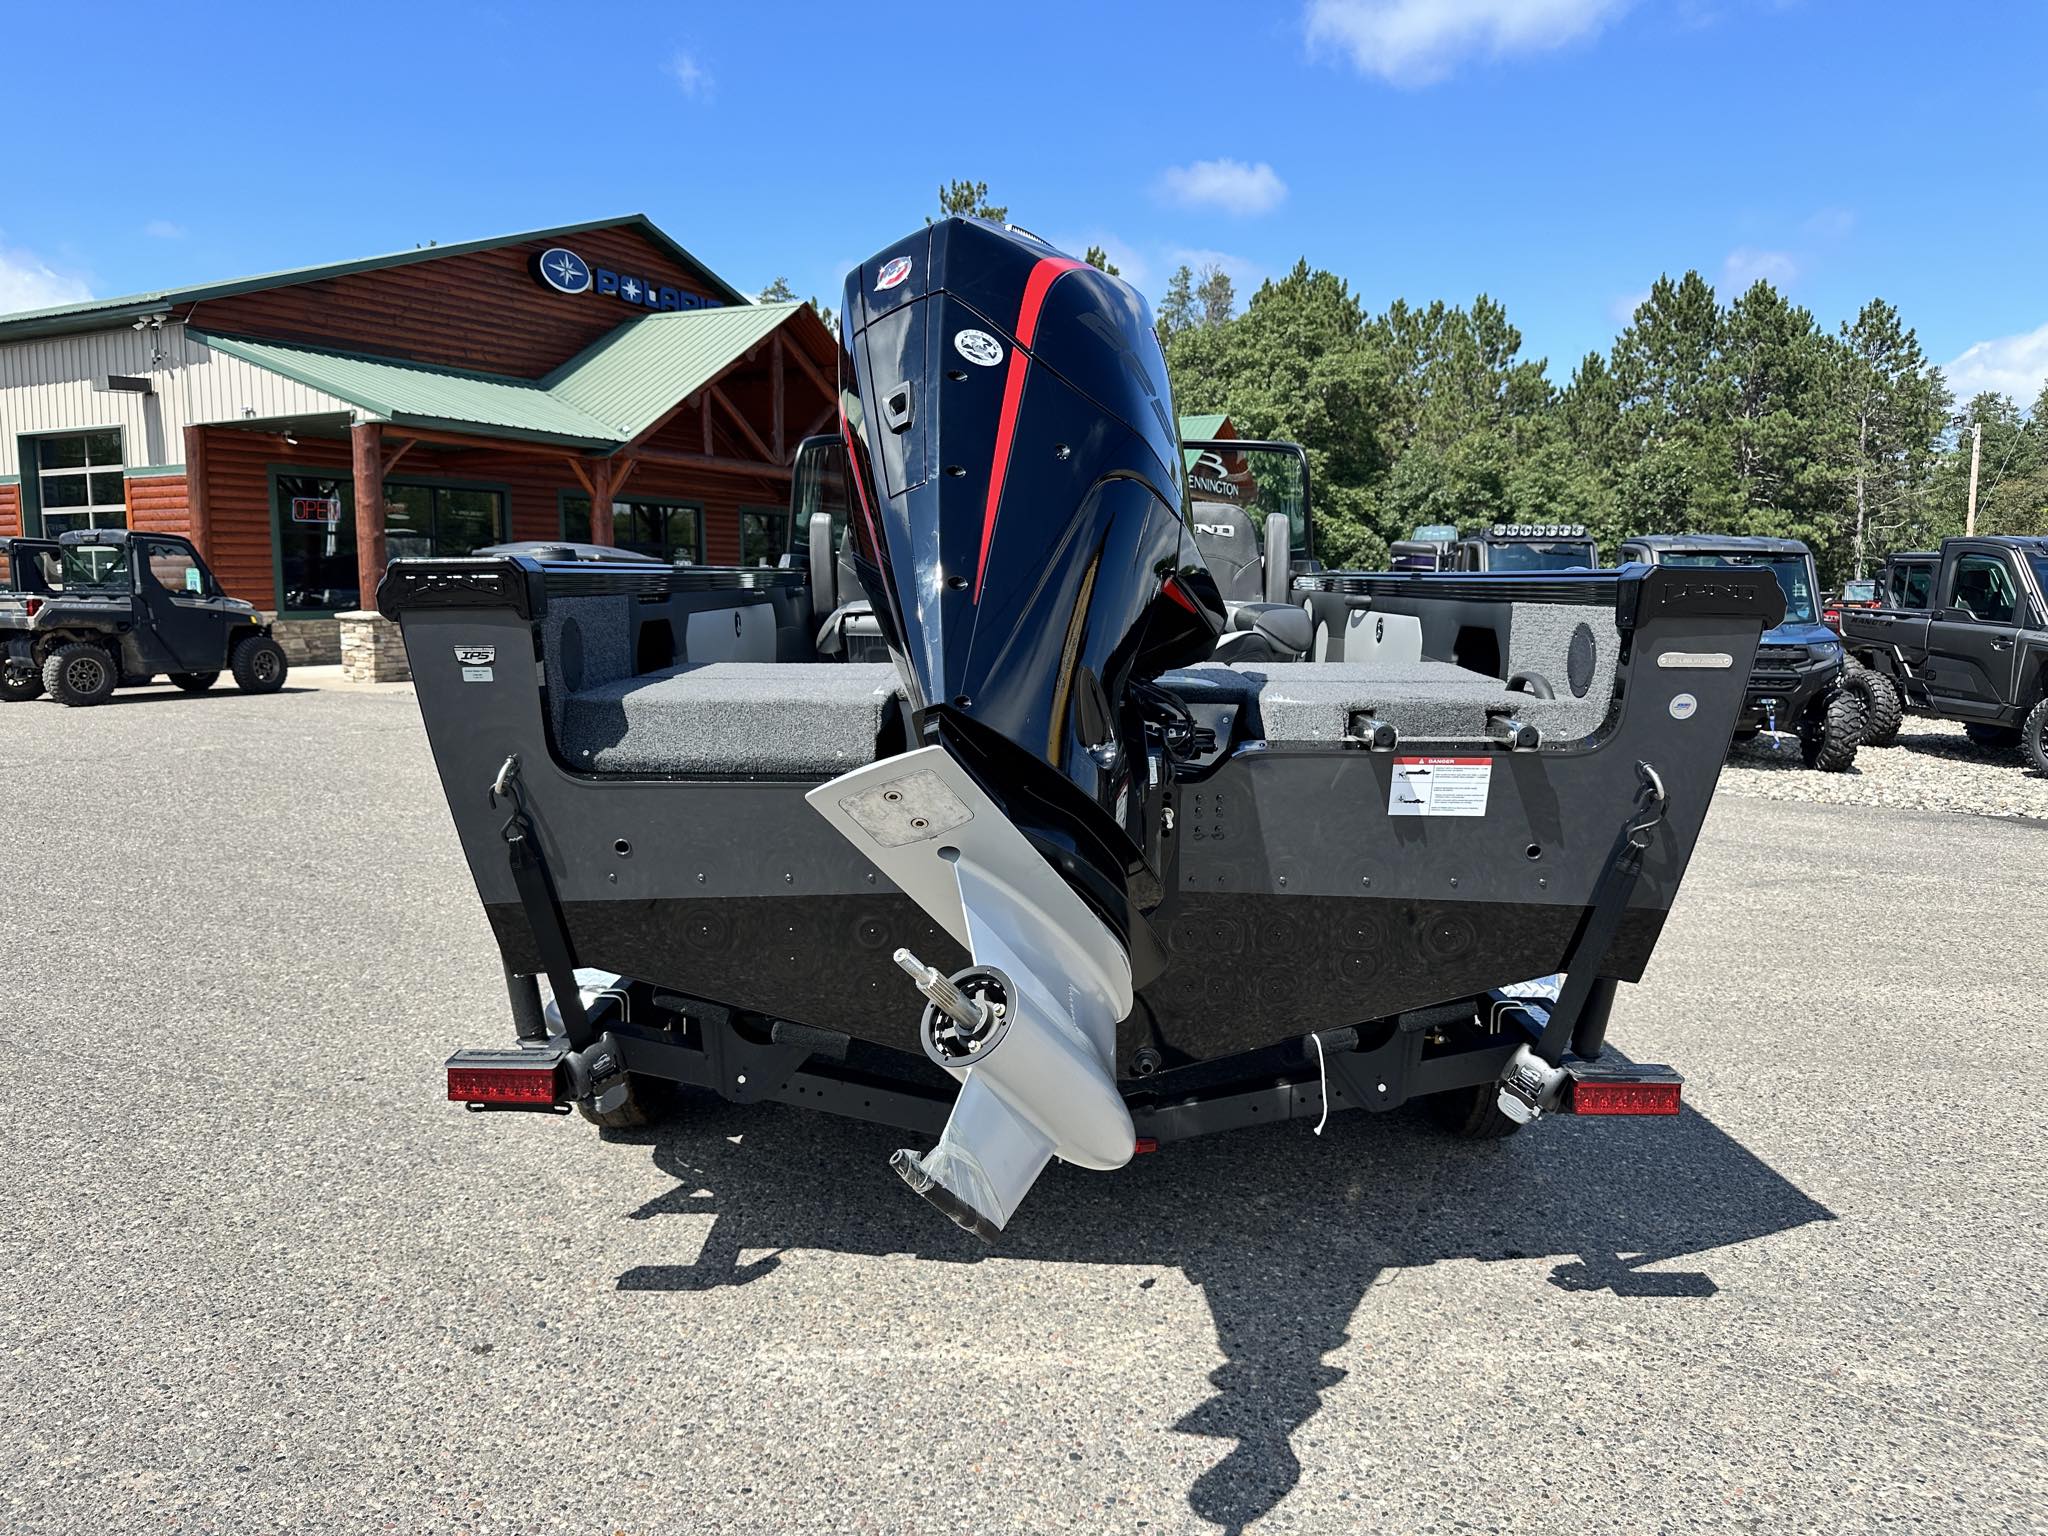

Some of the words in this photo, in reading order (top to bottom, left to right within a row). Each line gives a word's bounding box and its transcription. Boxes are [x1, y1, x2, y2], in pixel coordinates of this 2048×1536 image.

[1188, 475, 1240, 496] ENNINGTON
[294, 500, 340, 520] OPEN
[1194, 523, 1235, 538] ND
[1850, 616, 1895, 627] RANGER
